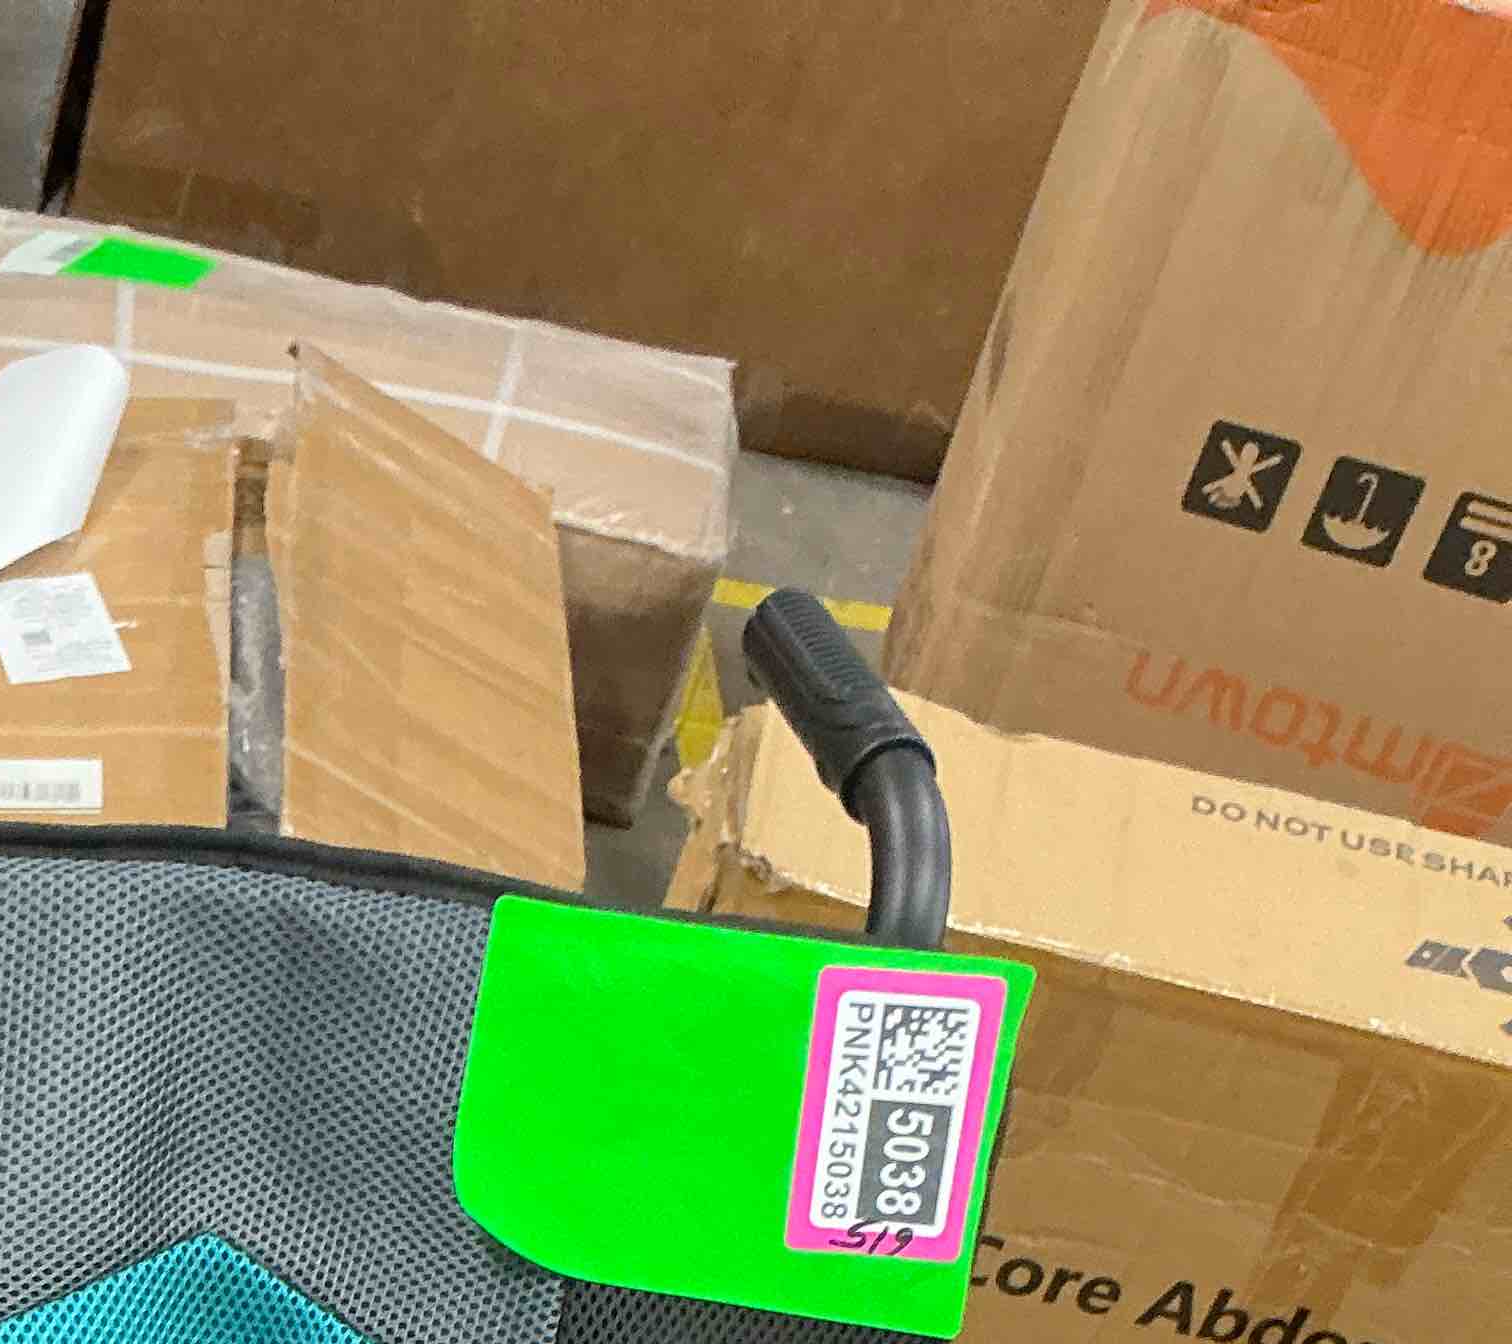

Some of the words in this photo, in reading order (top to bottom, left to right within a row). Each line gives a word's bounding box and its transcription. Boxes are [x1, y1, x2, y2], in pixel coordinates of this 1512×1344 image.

[1464, 539, 1497, 577] 8
[1191, 796, 1247, 823] DO
[1254, 809, 1333, 842] NOT
[1340, 829, 1415, 866] USE
[819, 1001, 876, 1220] PNK4215038
[874, 1107, 936, 1217] 5038
